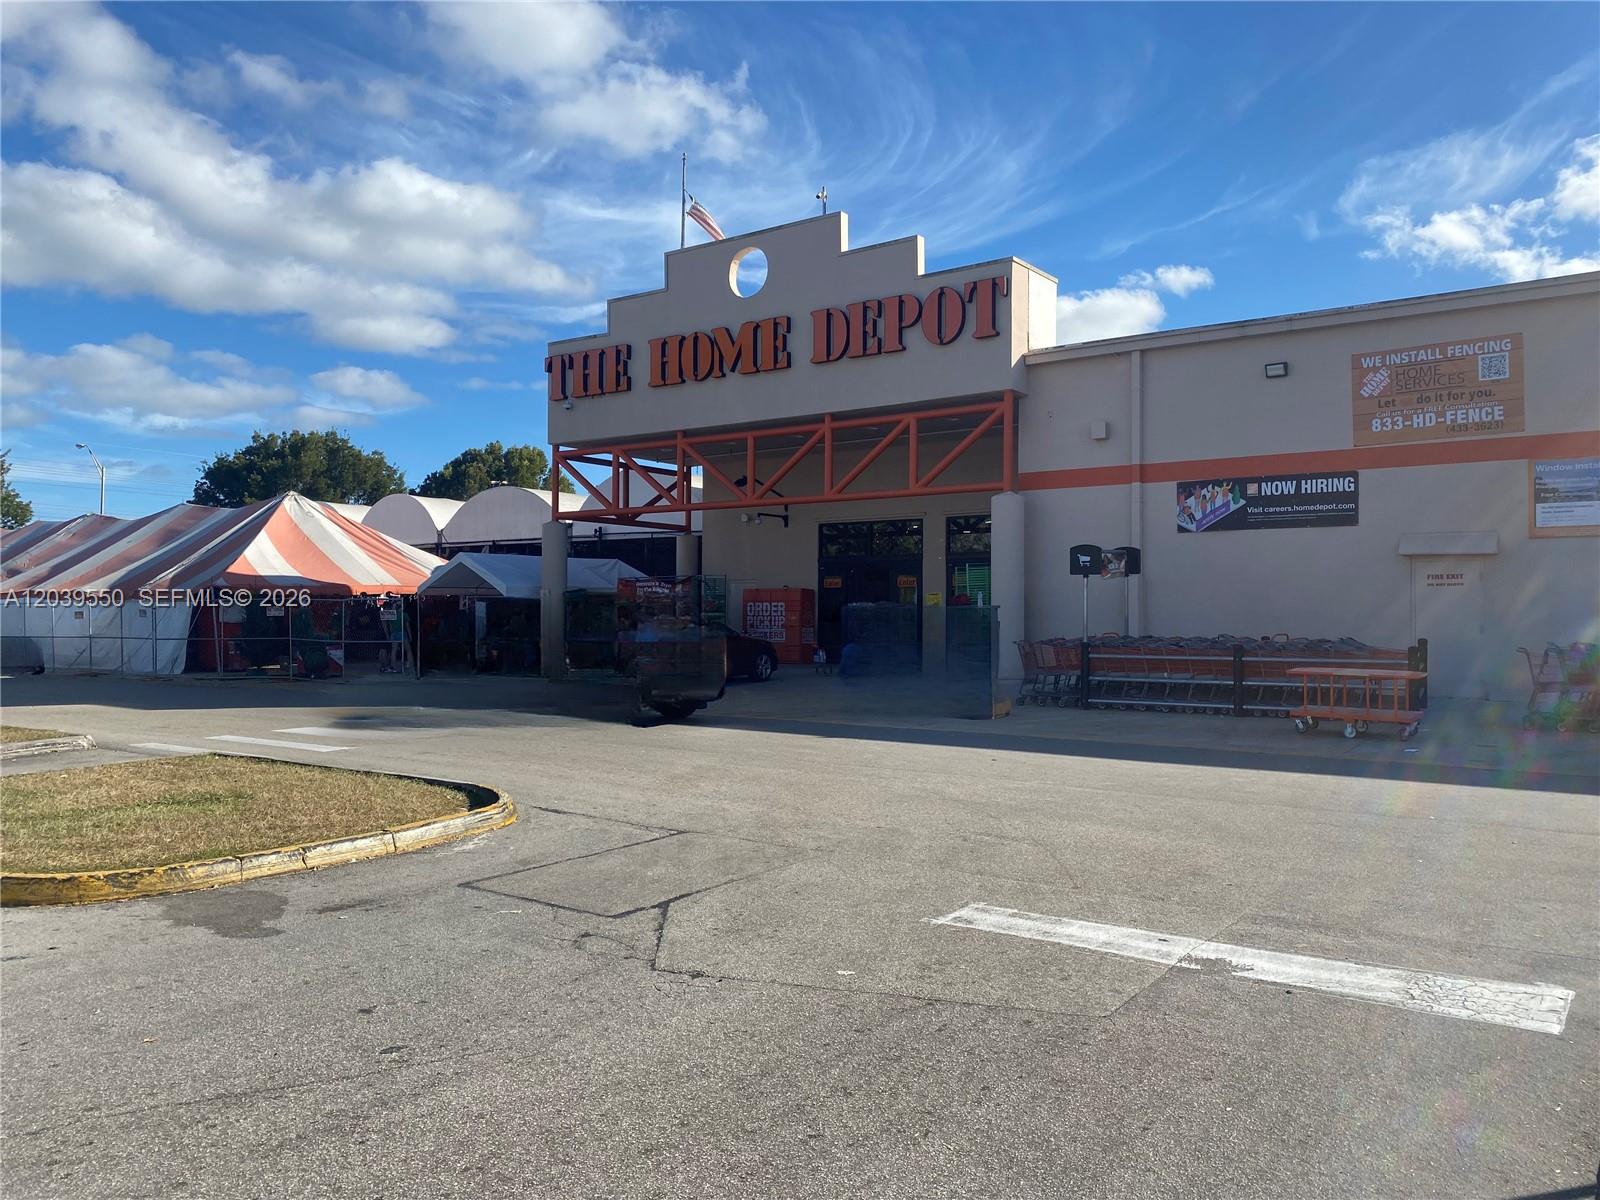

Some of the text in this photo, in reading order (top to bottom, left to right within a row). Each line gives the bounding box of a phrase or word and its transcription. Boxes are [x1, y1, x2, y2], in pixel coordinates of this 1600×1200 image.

[544, 276, 1009, 401] THE HOME DEPOT
[1361, 339, 1512, 369] WE INSTALL FENCING
[1395, 364, 1442, 380] HOME
[1395, 371, 1465, 391] SERVICES
[1359, 366, 1391, 398] HOME
[1378, 398, 1396, 409] Let
[1416, 394, 1431, 405] do
[1435, 391, 1443, 402] it
[1448, 390, 1466, 402] for
[1469, 389, 1496, 402] you.
[1371, 406, 1505, 433] 833-HD-FENCE
[1536, 464, 1573, 472] Window
[1261, 477, 1356, 496] NOW HIRING
[1247, 502, 1356, 514] Visit careers.homedepot.com
[747, 602, 786, 616] ORDER
[747, 615, 786, 629] PICKUP
